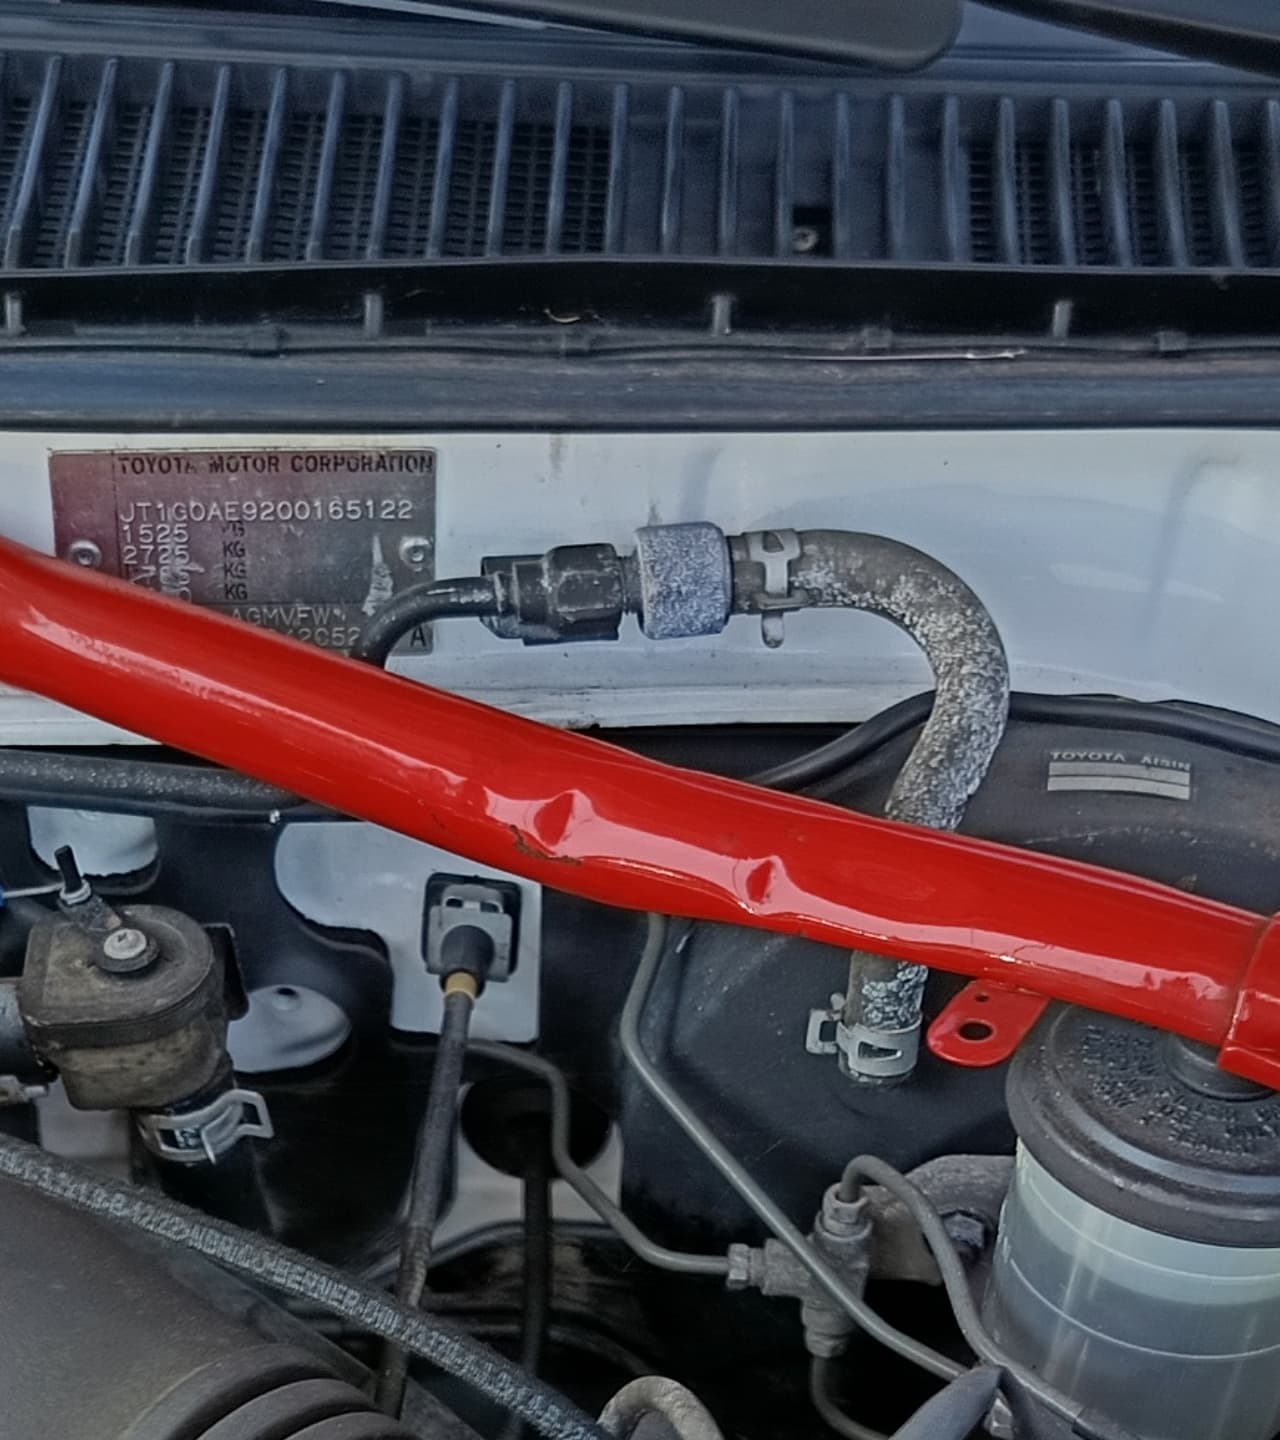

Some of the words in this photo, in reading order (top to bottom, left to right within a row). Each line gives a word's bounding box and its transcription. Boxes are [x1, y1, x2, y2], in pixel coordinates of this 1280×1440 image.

[120, 455, 197, 475] TOYOTA
[208, 455, 280, 474] MOTOR
[290, 454, 434, 474] CORPORATION
[122, 523, 189, 544] 1525
[122, 545, 190, 565] 2725
[223, 541, 246, 558] KG
[223, 562, 247, 580] KG
[224, 583, 248, 601] KG
[1050, 751, 1126, 763] TOYOTA
